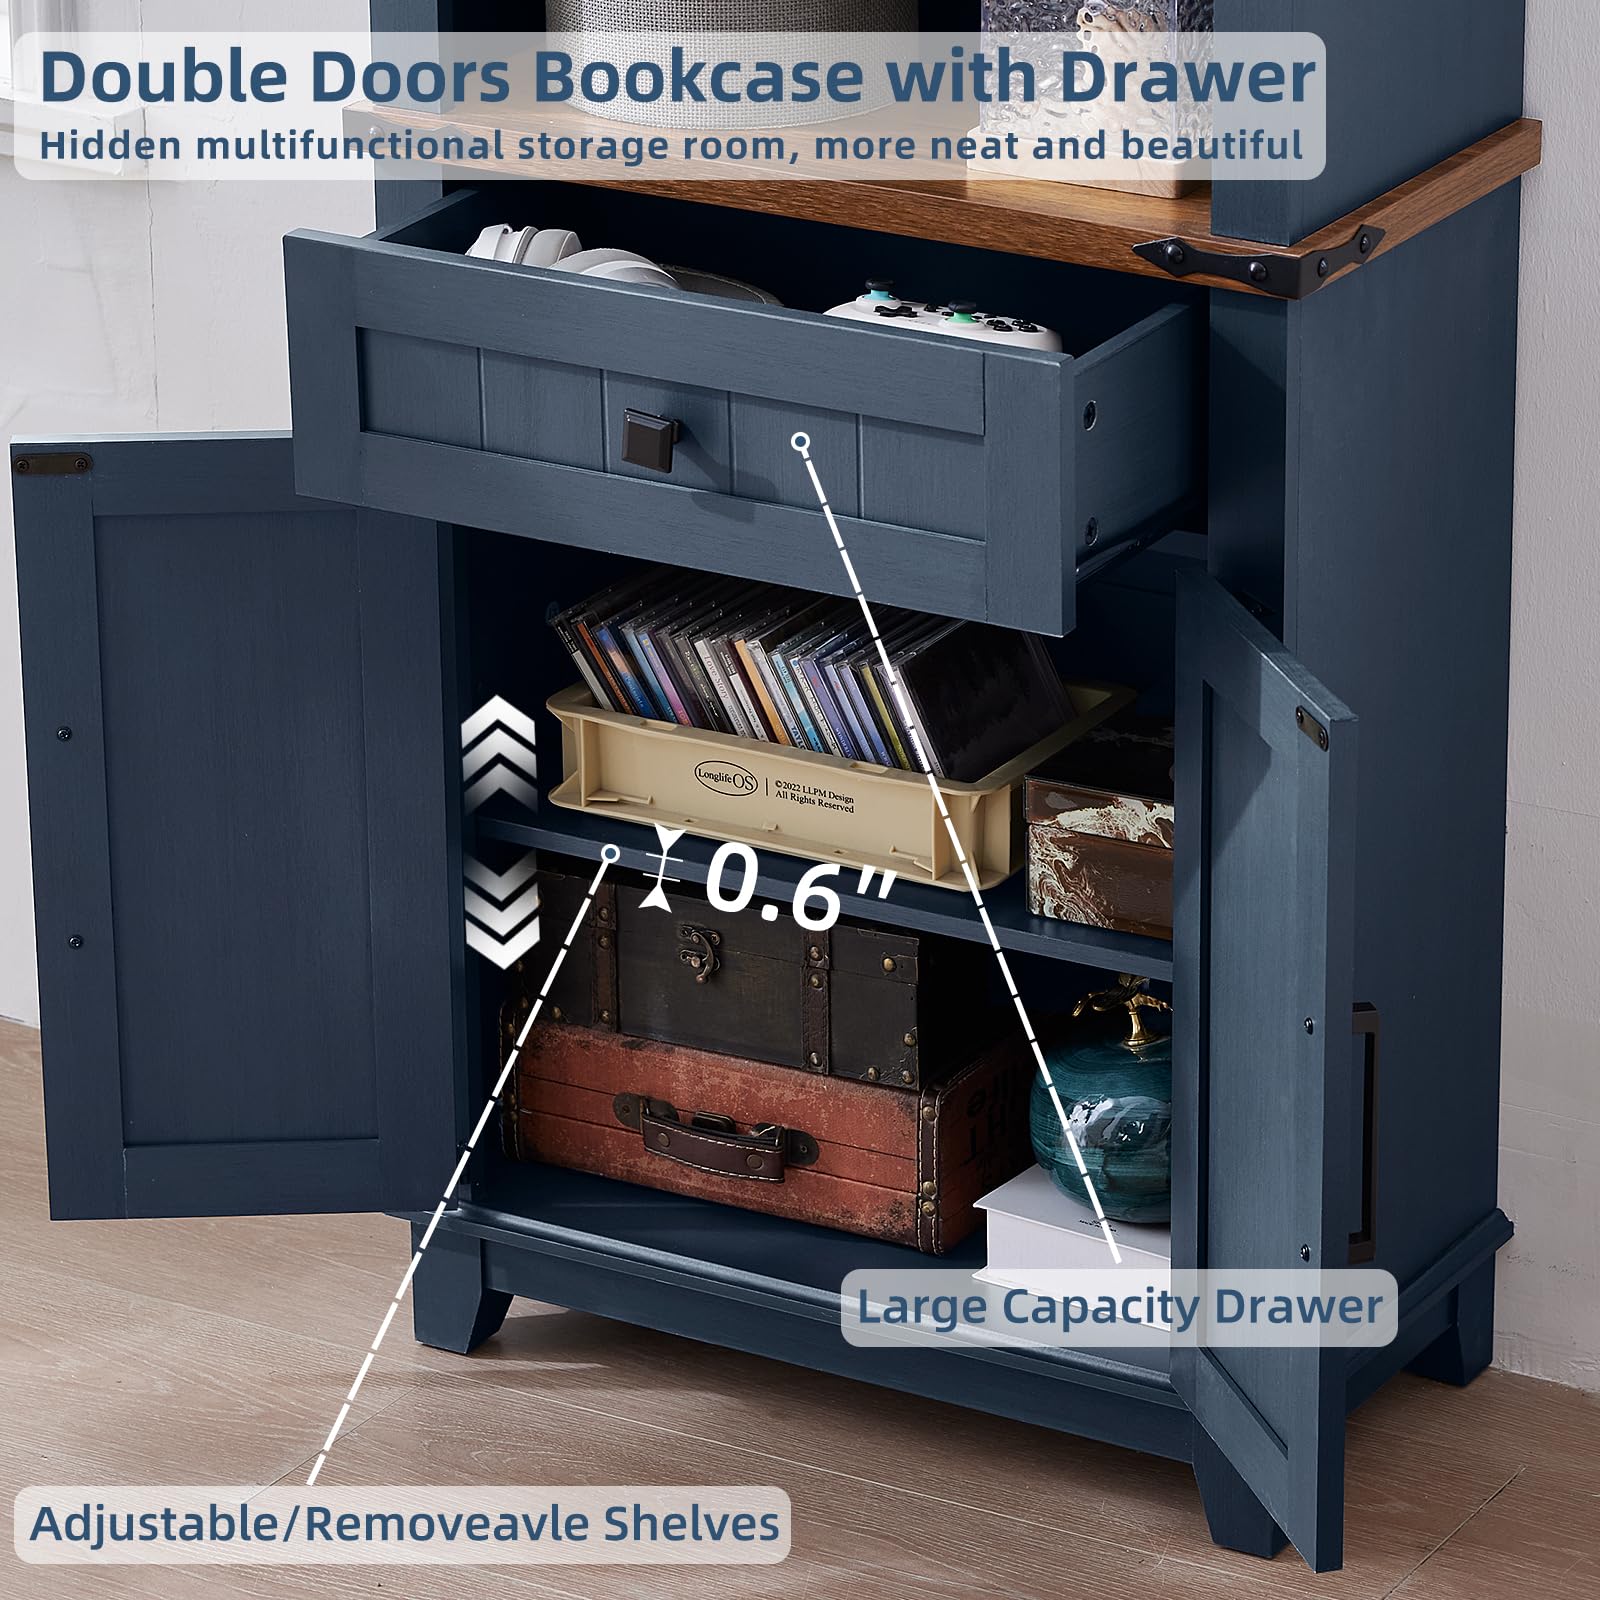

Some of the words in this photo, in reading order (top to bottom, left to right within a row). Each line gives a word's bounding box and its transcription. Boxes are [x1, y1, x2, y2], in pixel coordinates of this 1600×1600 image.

[775, 791, 788, 800] All
[790, 793, 816, 806] Rights
[817, 800, 855, 814] Reserved
[802, 785, 827, 798] LLPM
[828, 791, 854, 804] Design
